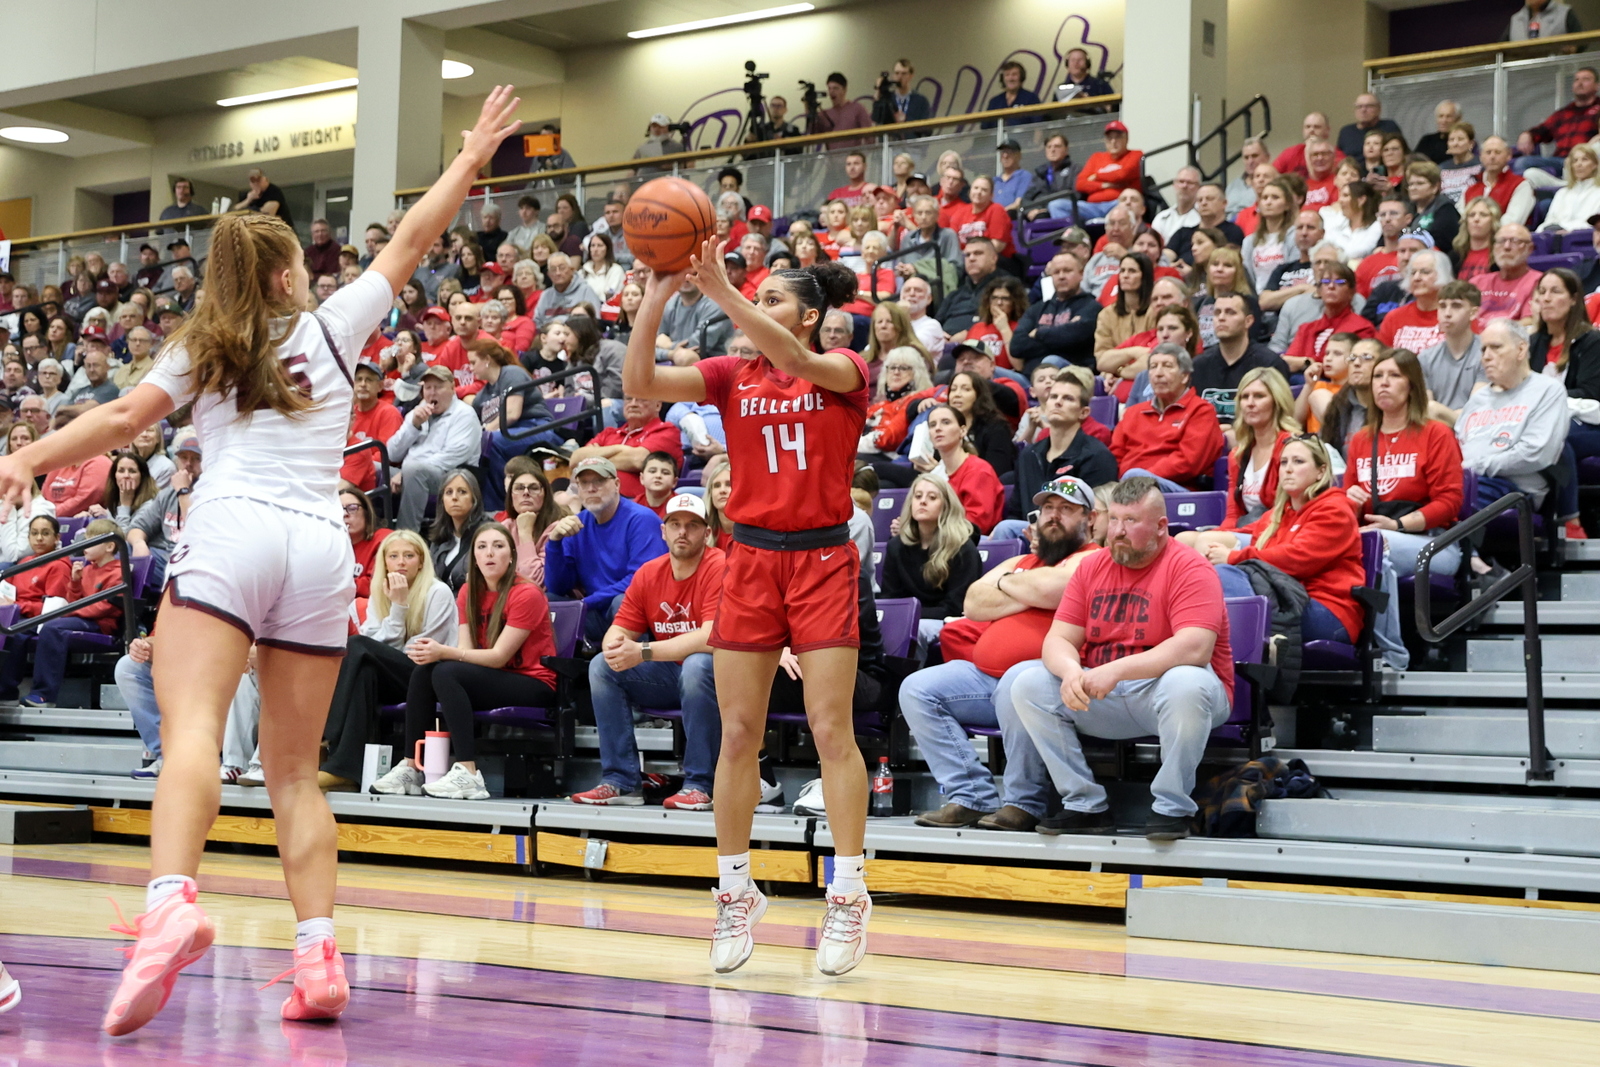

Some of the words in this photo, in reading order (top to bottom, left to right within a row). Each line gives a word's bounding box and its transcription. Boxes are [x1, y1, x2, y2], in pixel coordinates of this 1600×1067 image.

[253, 136, 280, 154] AND
[290, 126, 342, 148] WEIGHT
[740, 392, 824, 418] BELLEVUE
[1491, 405, 1528, 425] STATE
[761, 422, 807, 474] 14
[1356, 452, 1418, 469] BELEVUE
[1090, 593, 1150, 624] STATE
